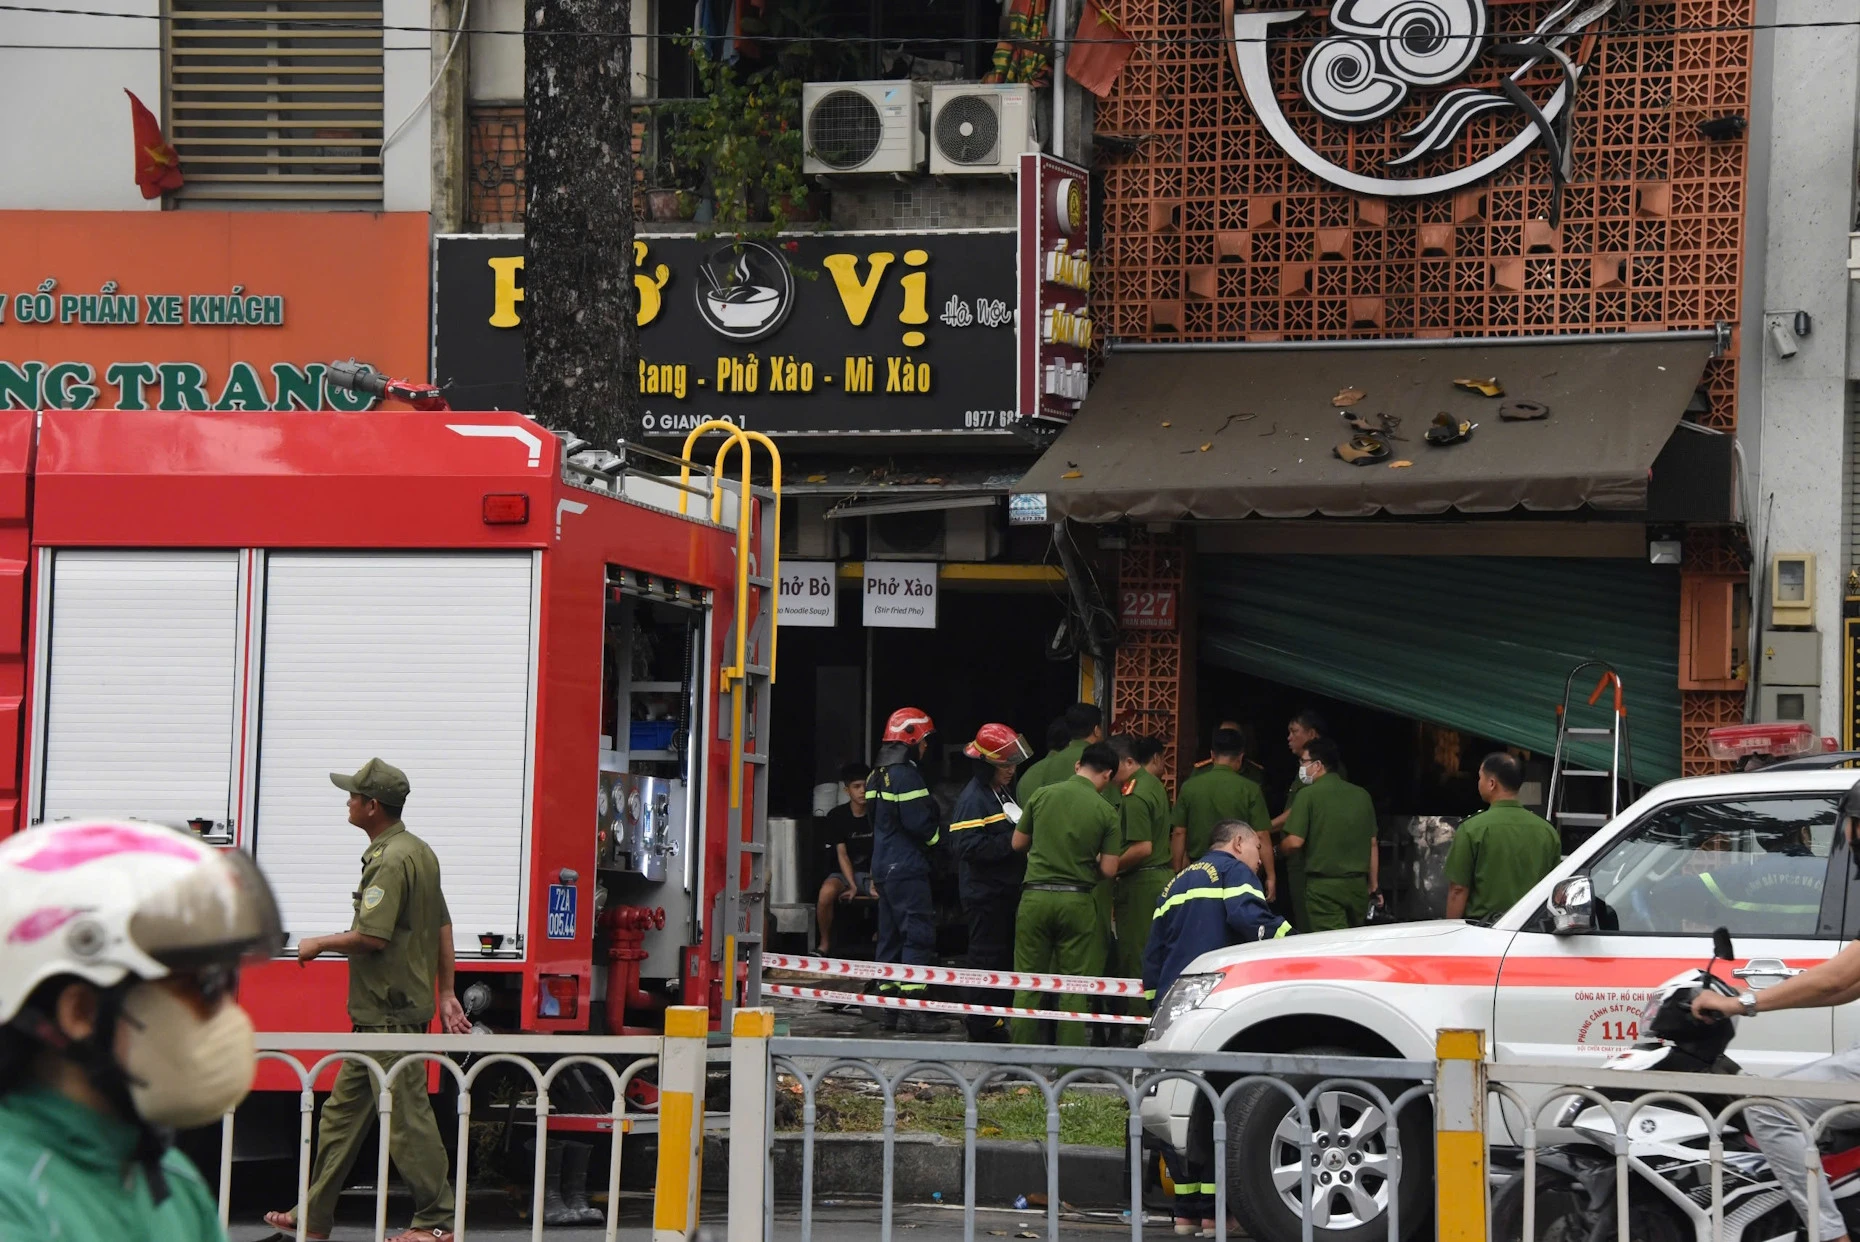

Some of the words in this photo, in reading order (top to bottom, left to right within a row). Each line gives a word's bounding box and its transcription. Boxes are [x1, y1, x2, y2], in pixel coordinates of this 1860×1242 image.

[14, 277, 57, 324] CỔ
[61, 280, 139, 325] PHẦN
[145, 295, 184, 325] XE
[188, 285, 284, 326] KHÁCH
[823, 249, 929, 347] Vị
[940, 294, 973, 328] Hà
[976, 297, 1012, 328] Nội
[716, 353, 760, 393] Phở
[769, 355, 814, 392] Xào
[844, 355, 874, 393] Mì
[886, 355, 931, 393] Xào
[965, 410, 995, 428] 0977
[809, 576, 831, 596] Bò
[867, 577, 900, 596] Phở
[903, 578, 933, 597] Xào
[1122, 592, 1172, 616] 227
[555, 888, 570, 911] 72A
[549, 912, 575, 936] 005.44
[1575, 990, 1594, 1001] CÔNG
[1596, 992, 1605, 1001] AN
[1609, 1004, 1624, 1012] SÁT
[1602, 1020, 1639, 1040] 114
